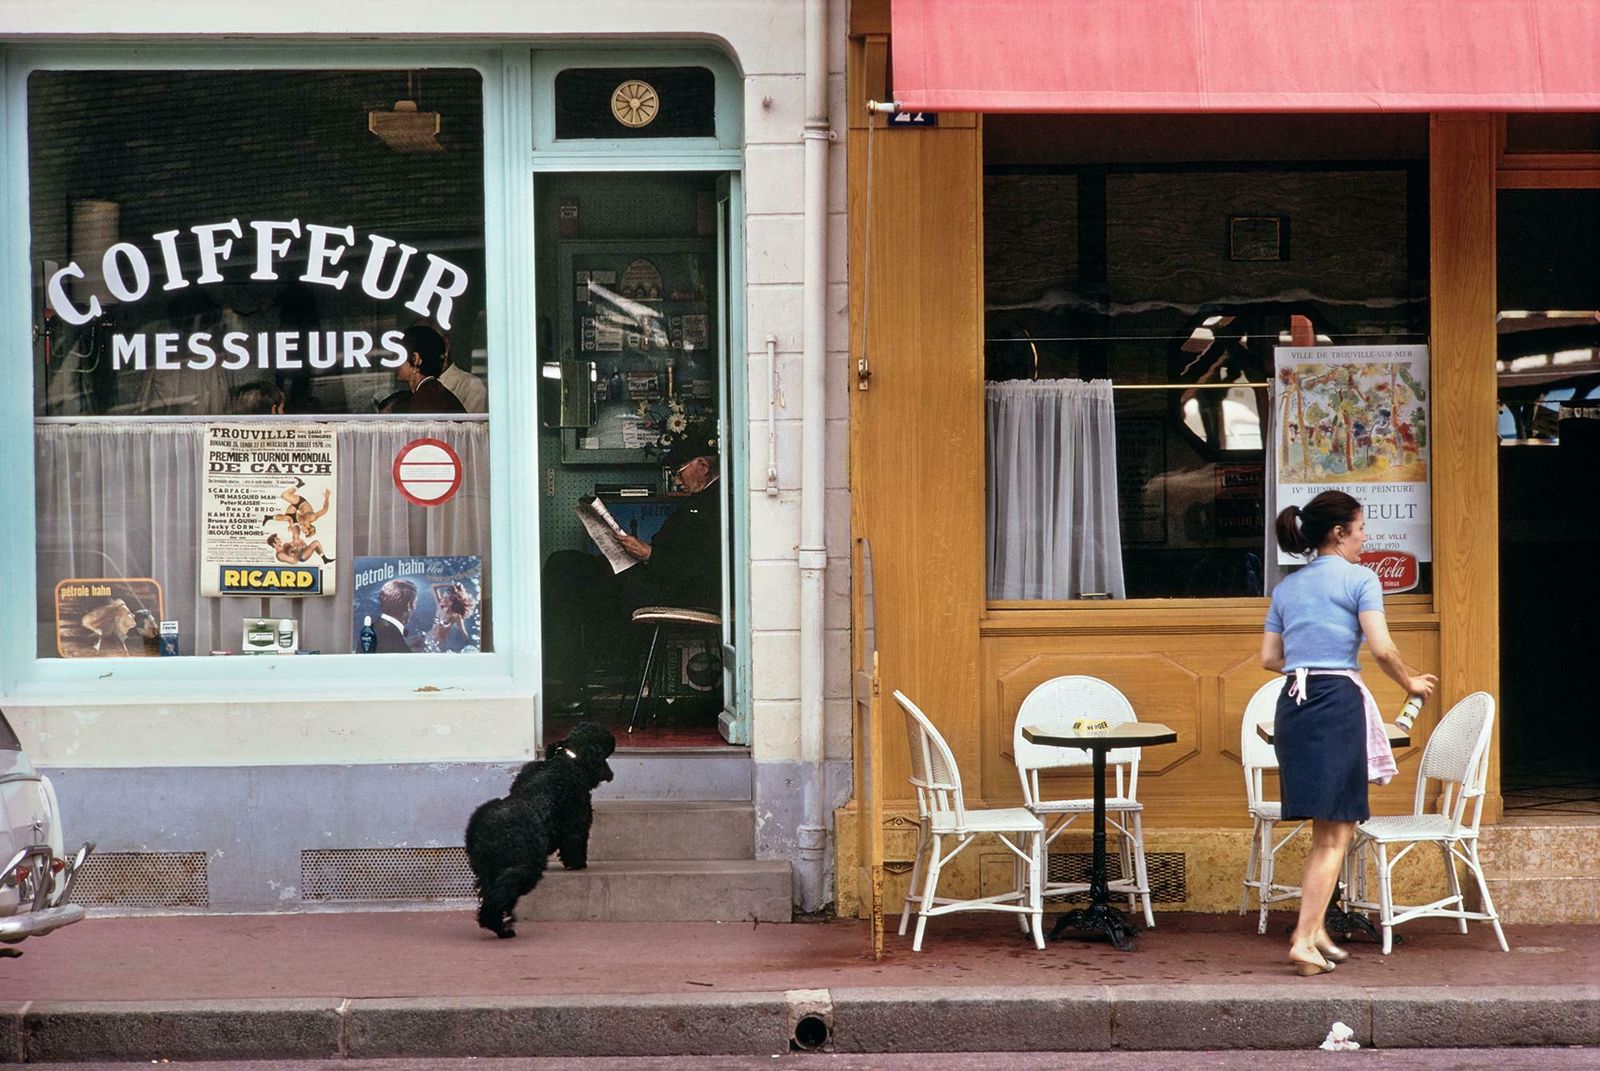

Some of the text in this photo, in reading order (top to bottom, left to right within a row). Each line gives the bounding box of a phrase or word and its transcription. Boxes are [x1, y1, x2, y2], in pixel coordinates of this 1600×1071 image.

[47, 218, 469, 331] COIFFEUR
[112, 331, 408, 370] MESSIEURS
[210, 428, 295, 440] TROUVILLE
[210, 451, 332, 463] PREMIER TOURNOI MONDIAL
[208, 462, 332, 474] DE CATCH
[1356, 485, 1366, 493] DE
[1372, 484, 1414, 492] PEINTURE
[1360, 504, 1417, 519] EULT
[224, 570, 314, 588] RICARD
[355, 563, 394, 590] pétrole
[398, 559, 425, 576] hahn
[61, 585, 112, 599] pétrole hahn
